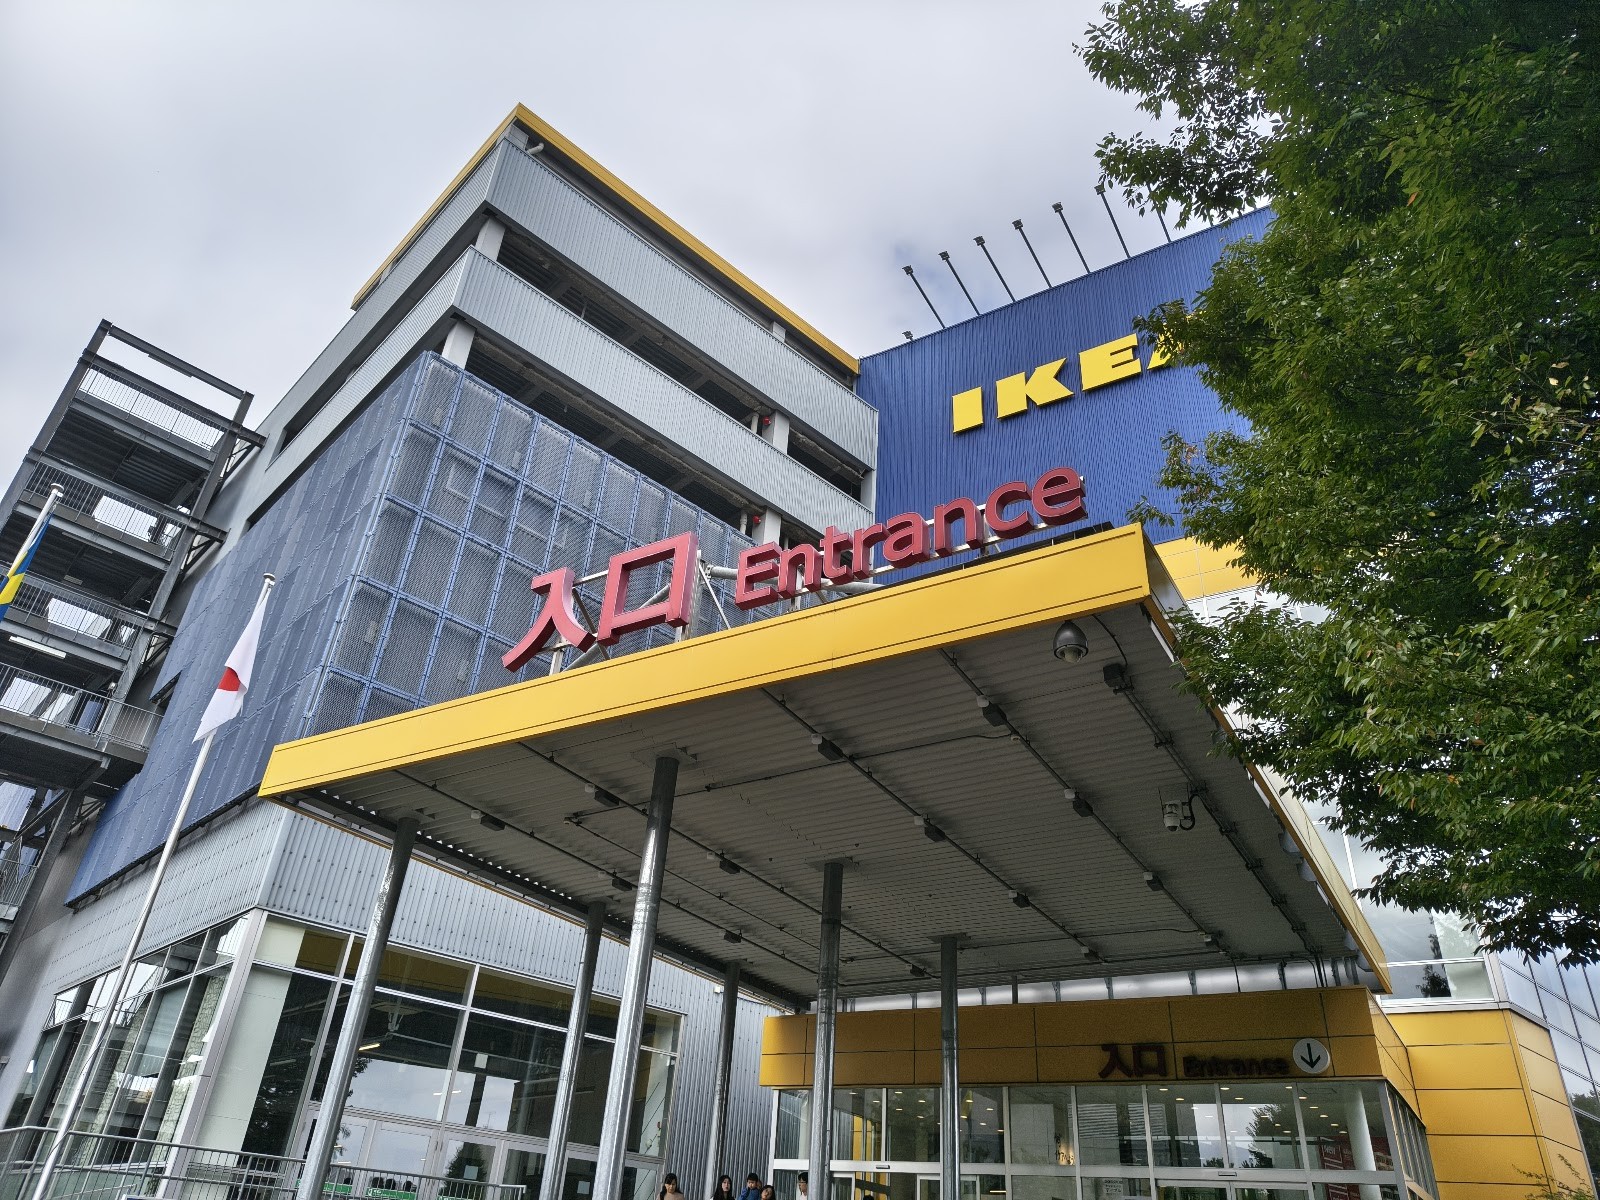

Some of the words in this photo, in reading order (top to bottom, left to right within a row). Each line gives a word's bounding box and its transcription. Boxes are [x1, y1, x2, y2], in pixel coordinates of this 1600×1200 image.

[502, 532, 697, 671] 入口
[735, 466, 1086, 610] Entrance
[1098, 1043, 1167, 1078] 入口
[1182, 1056, 1289, 1077] Entrance
